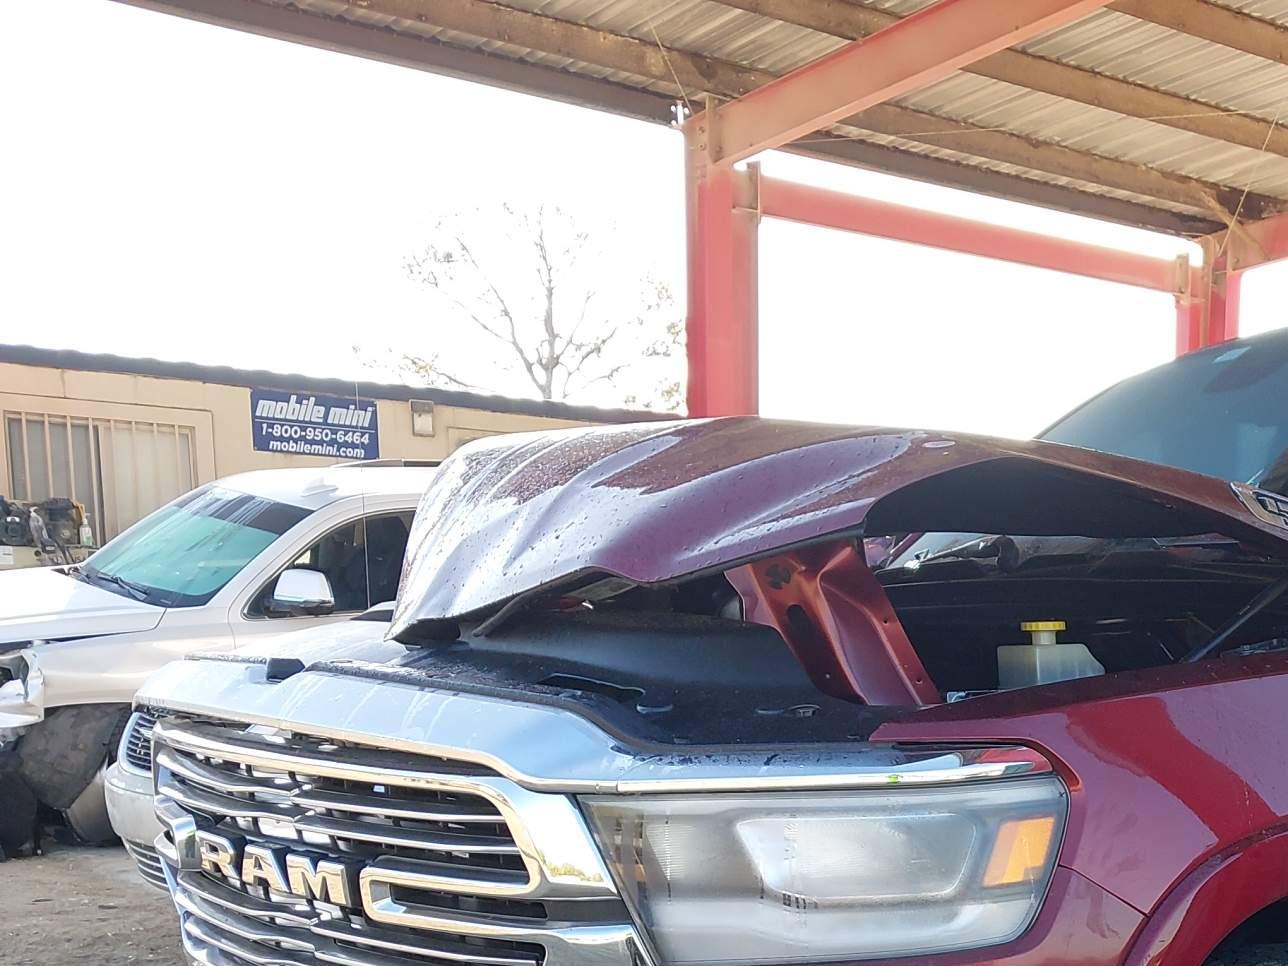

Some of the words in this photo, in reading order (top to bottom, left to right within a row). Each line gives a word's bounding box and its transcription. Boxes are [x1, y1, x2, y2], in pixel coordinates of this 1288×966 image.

[255, 394, 326, 422] mobile
[327, 405, 373, 427] mini
[261, 423, 370, 445] 1-800-950-6464
[269, 439, 365, 458] mobilemini.com
[197, 829, 350, 906] RAM
